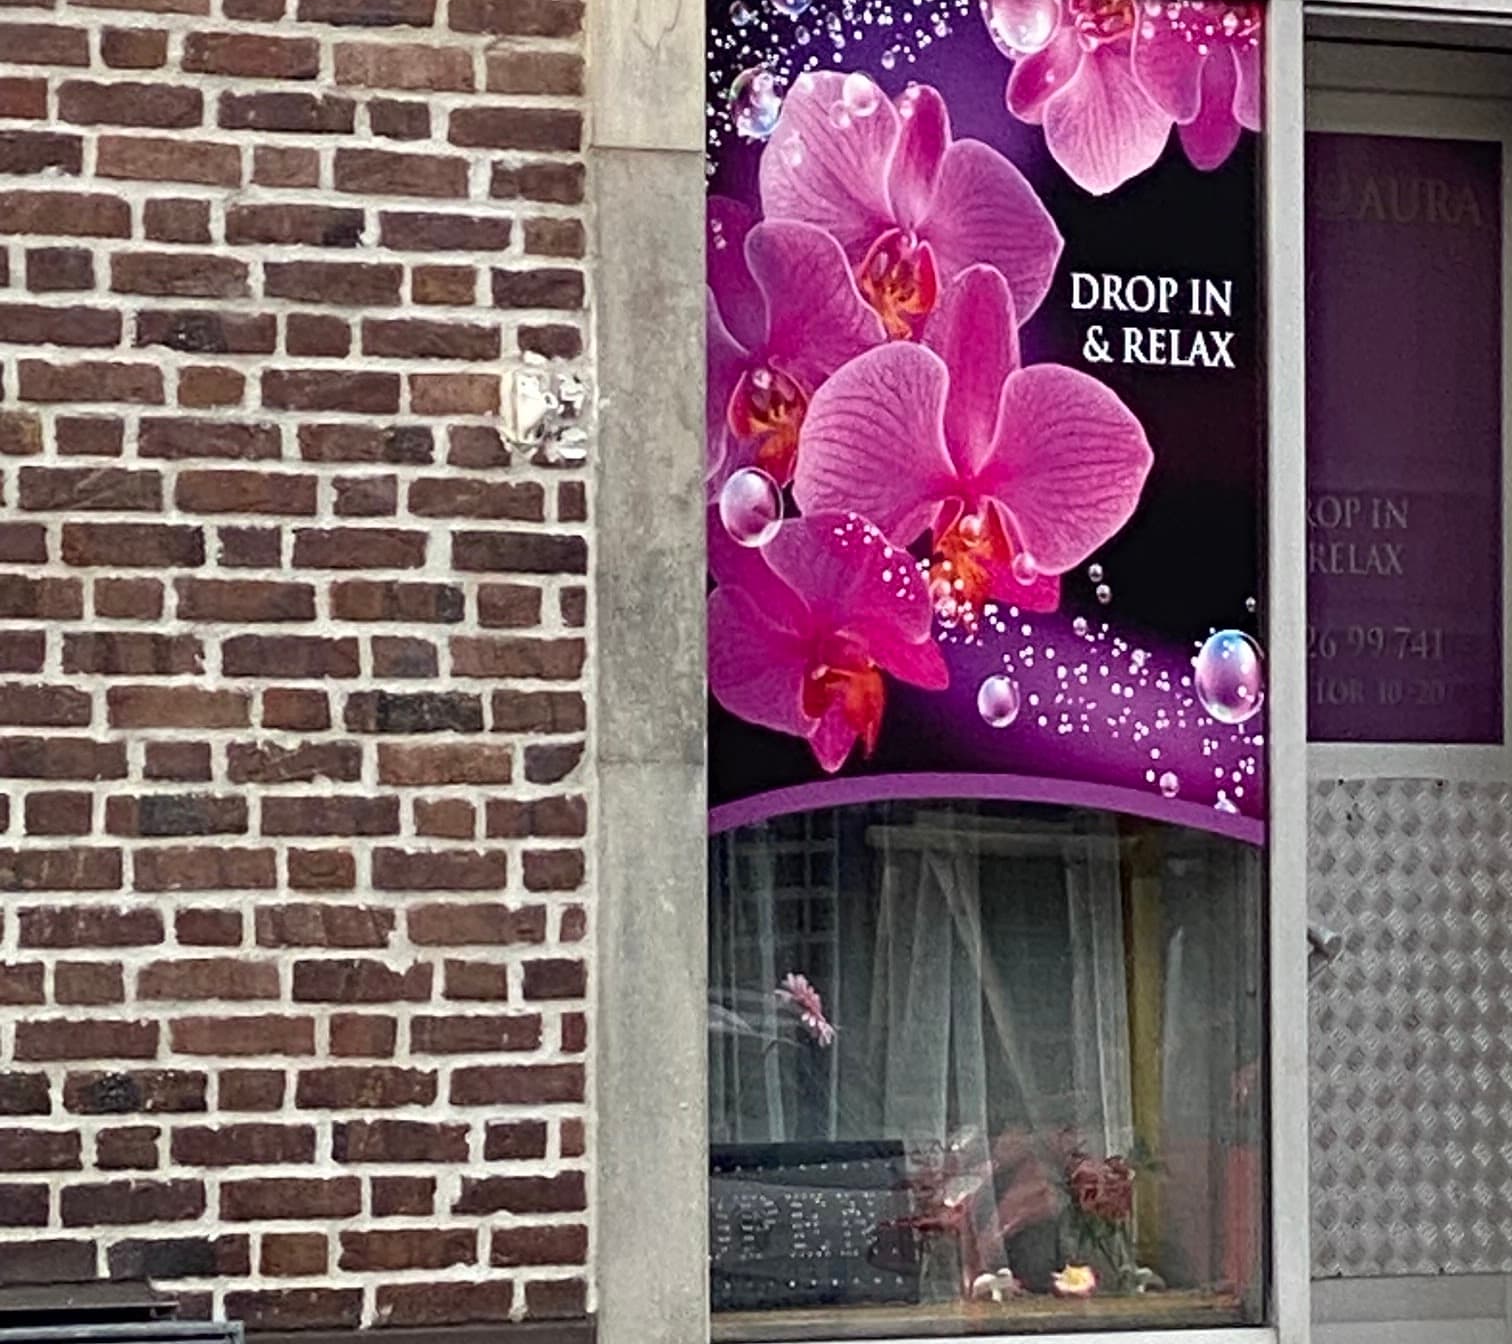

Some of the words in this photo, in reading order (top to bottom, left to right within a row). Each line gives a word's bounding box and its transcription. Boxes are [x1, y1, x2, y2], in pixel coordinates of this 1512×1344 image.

[1070, 271, 1178, 313] DROP
[1188, 278, 1233, 317] IN
[1082, 324, 1115, 363] &
[1121, 326, 1236, 369] RELAX
[1372, 497, 1409, 529] IN
[1309, 540, 1404, 576] RELAX
[1393, 626, 1444, 660] 741
